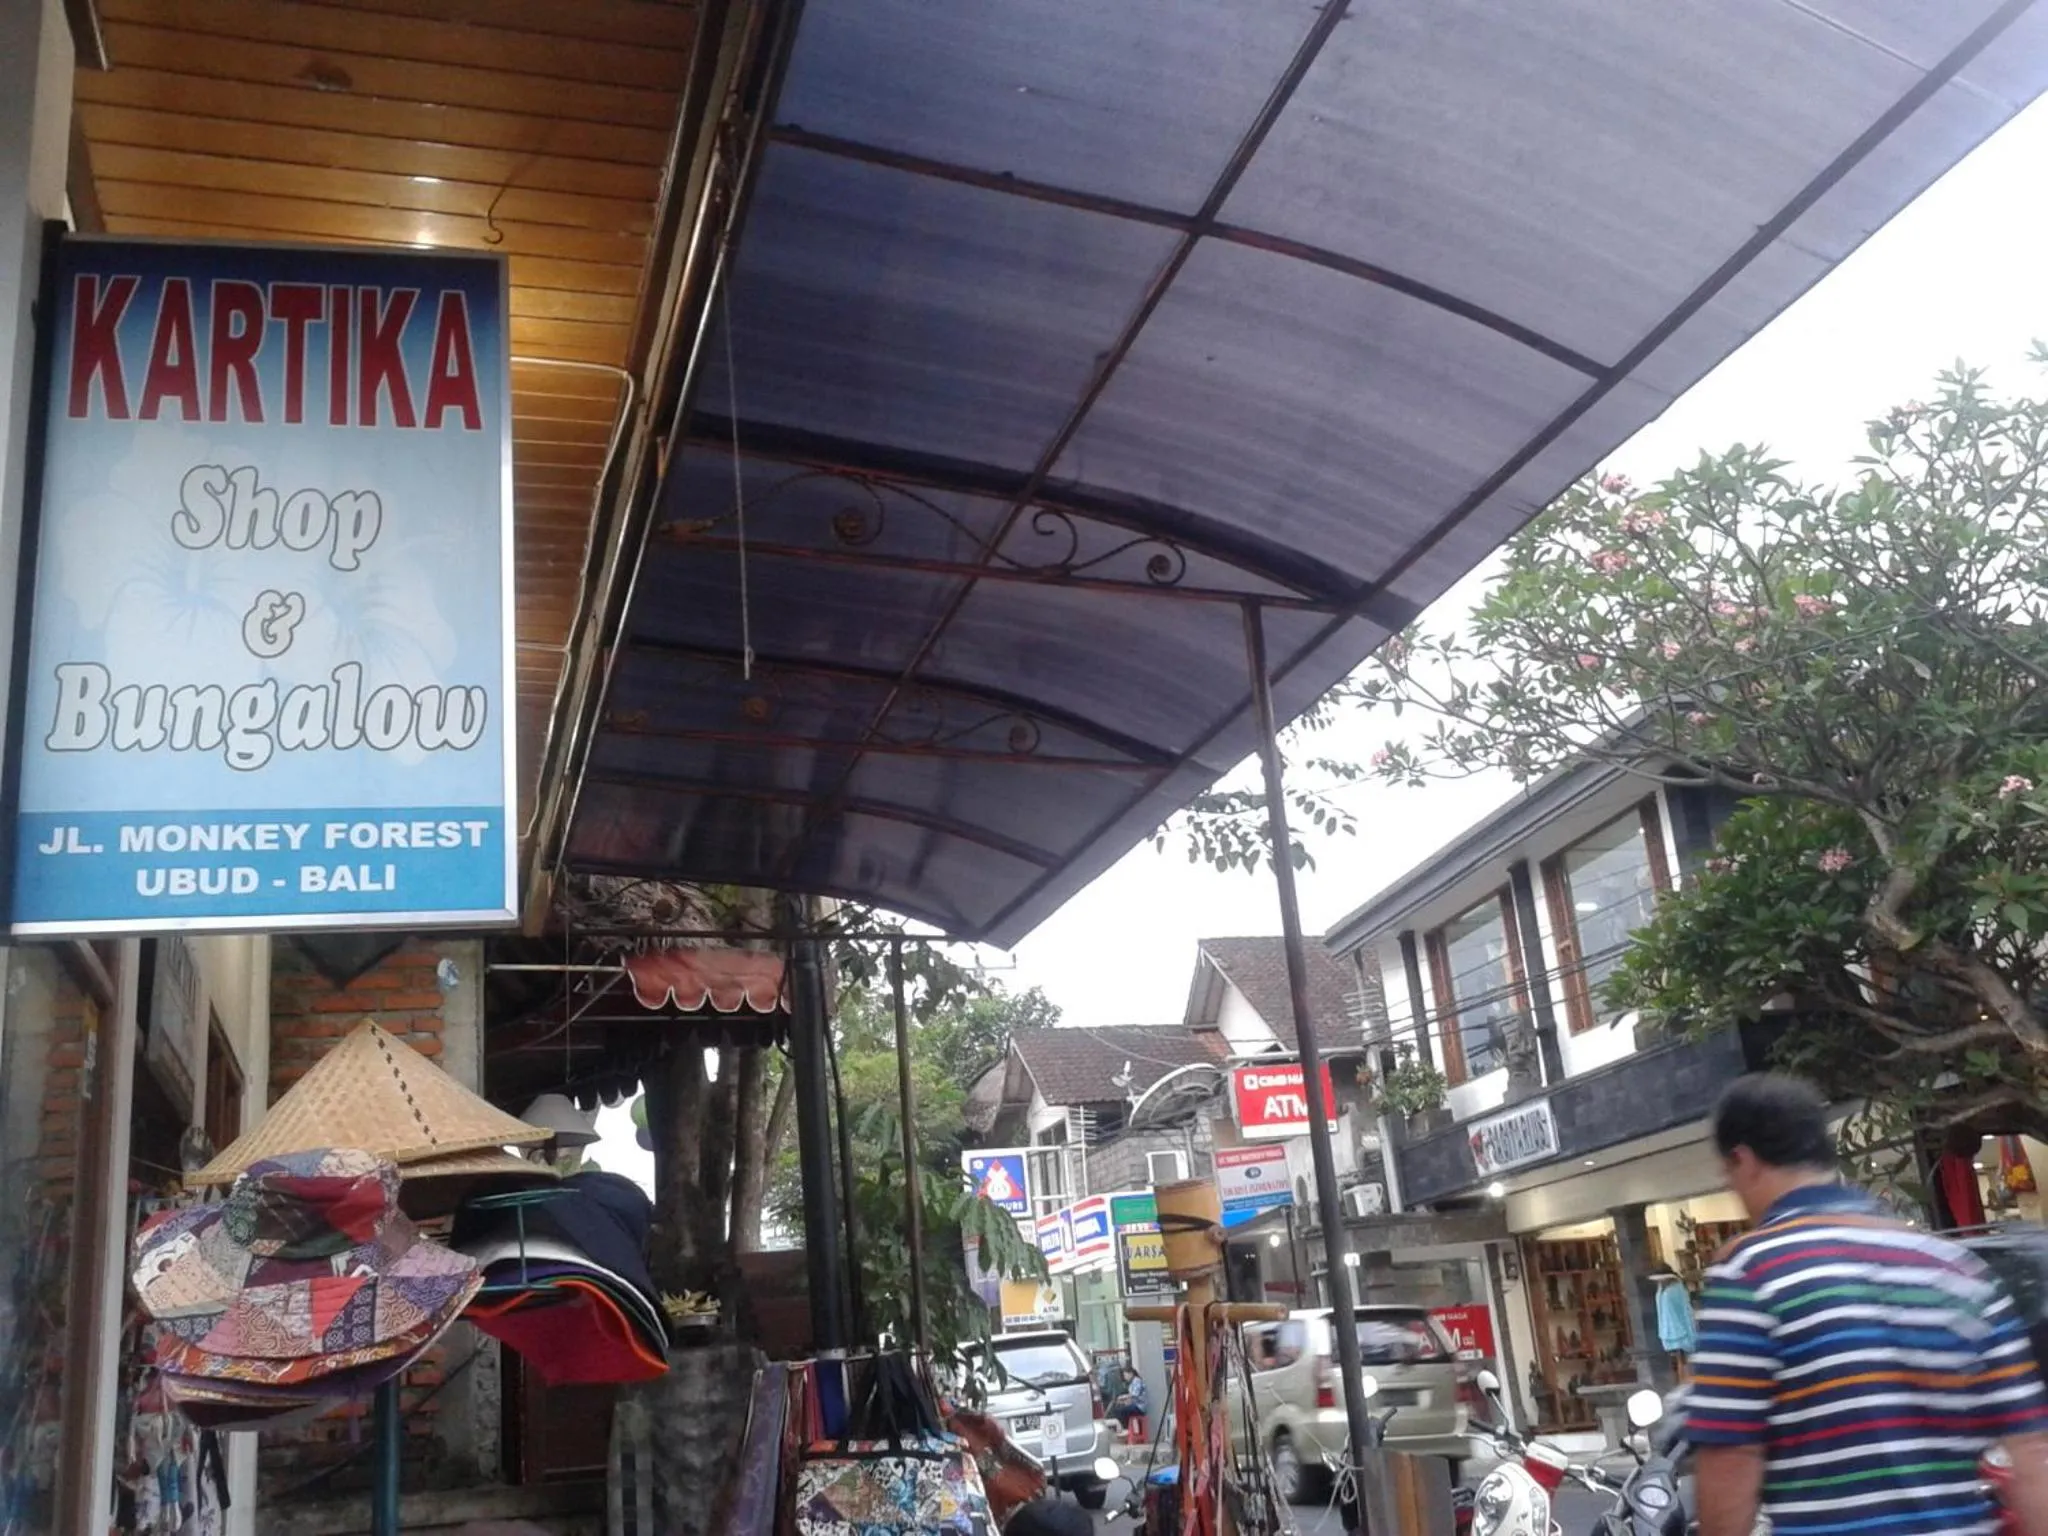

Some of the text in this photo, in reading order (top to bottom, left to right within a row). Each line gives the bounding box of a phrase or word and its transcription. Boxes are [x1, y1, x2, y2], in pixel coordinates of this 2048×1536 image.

[67, 272, 486, 431] KARTIKA
[171, 465, 382, 572] Shop
[242, 589, 306, 659] &
[45, 661, 488, 772] Bungalow
[38, 820, 489, 857] JL. MONKEY FOREST
[136, 866, 257, 897] UBUD
[299, 862, 396, 893] BALI
